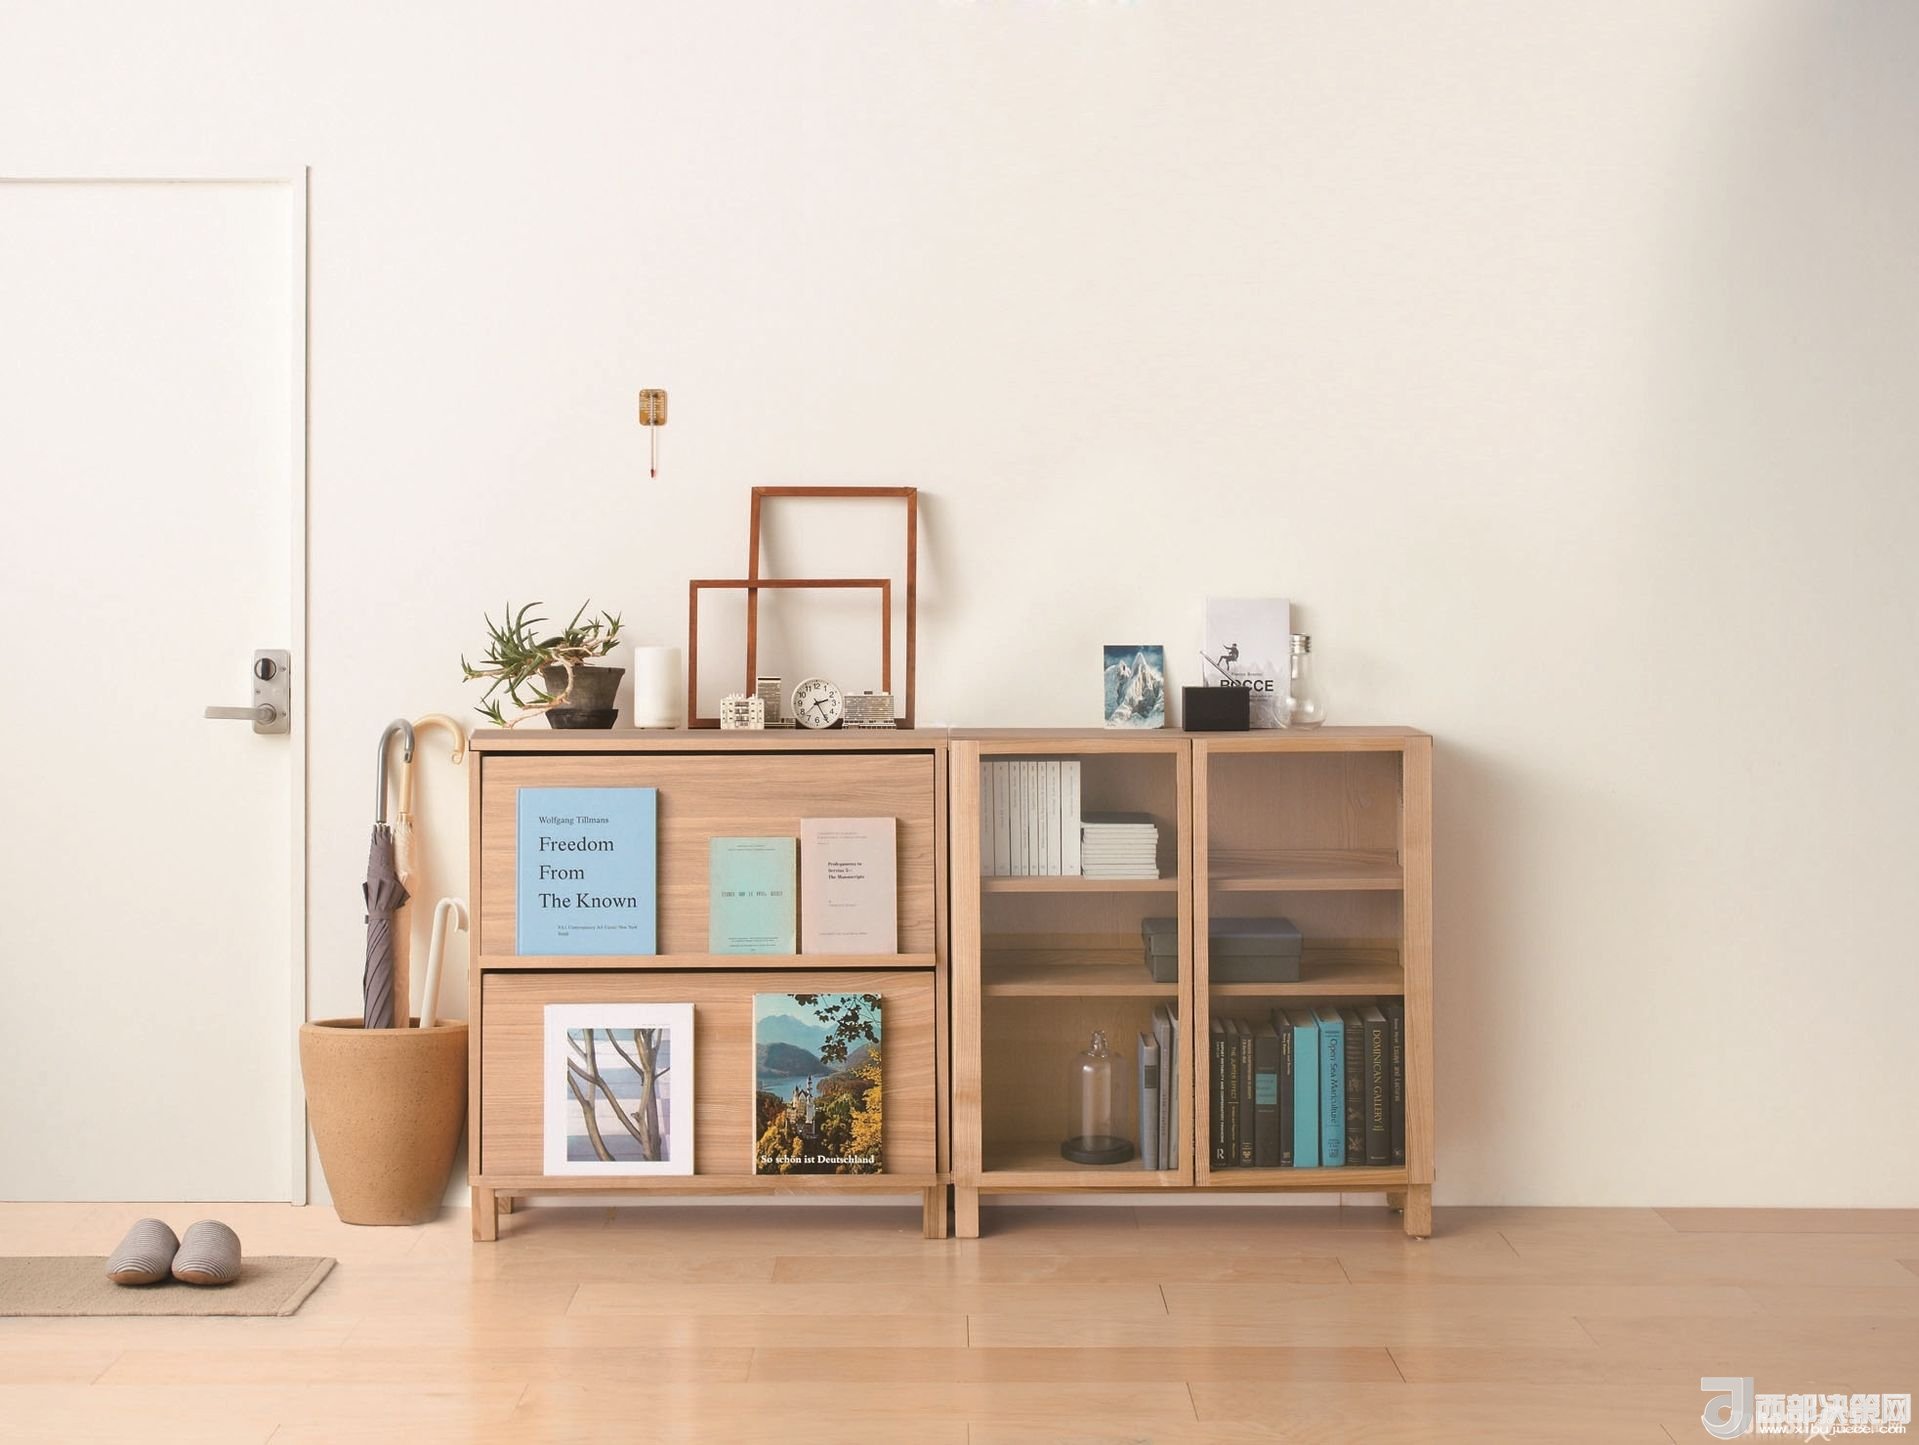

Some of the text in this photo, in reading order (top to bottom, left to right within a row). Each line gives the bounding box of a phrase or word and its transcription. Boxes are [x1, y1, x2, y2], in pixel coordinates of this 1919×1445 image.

[539, 816, 574, 825] Wolfgang
[539, 837, 614, 852] Freedom
[539, 865, 585, 880] From
[539, 893, 637, 908] The Known
[1328, 1038, 1338, 1123] Open Sea Mariculture
[1372, 1030, 1384, 1125] DOMINICAN GALLERY
[761, 1154, 875, 1164] So schön ist Deutschland
